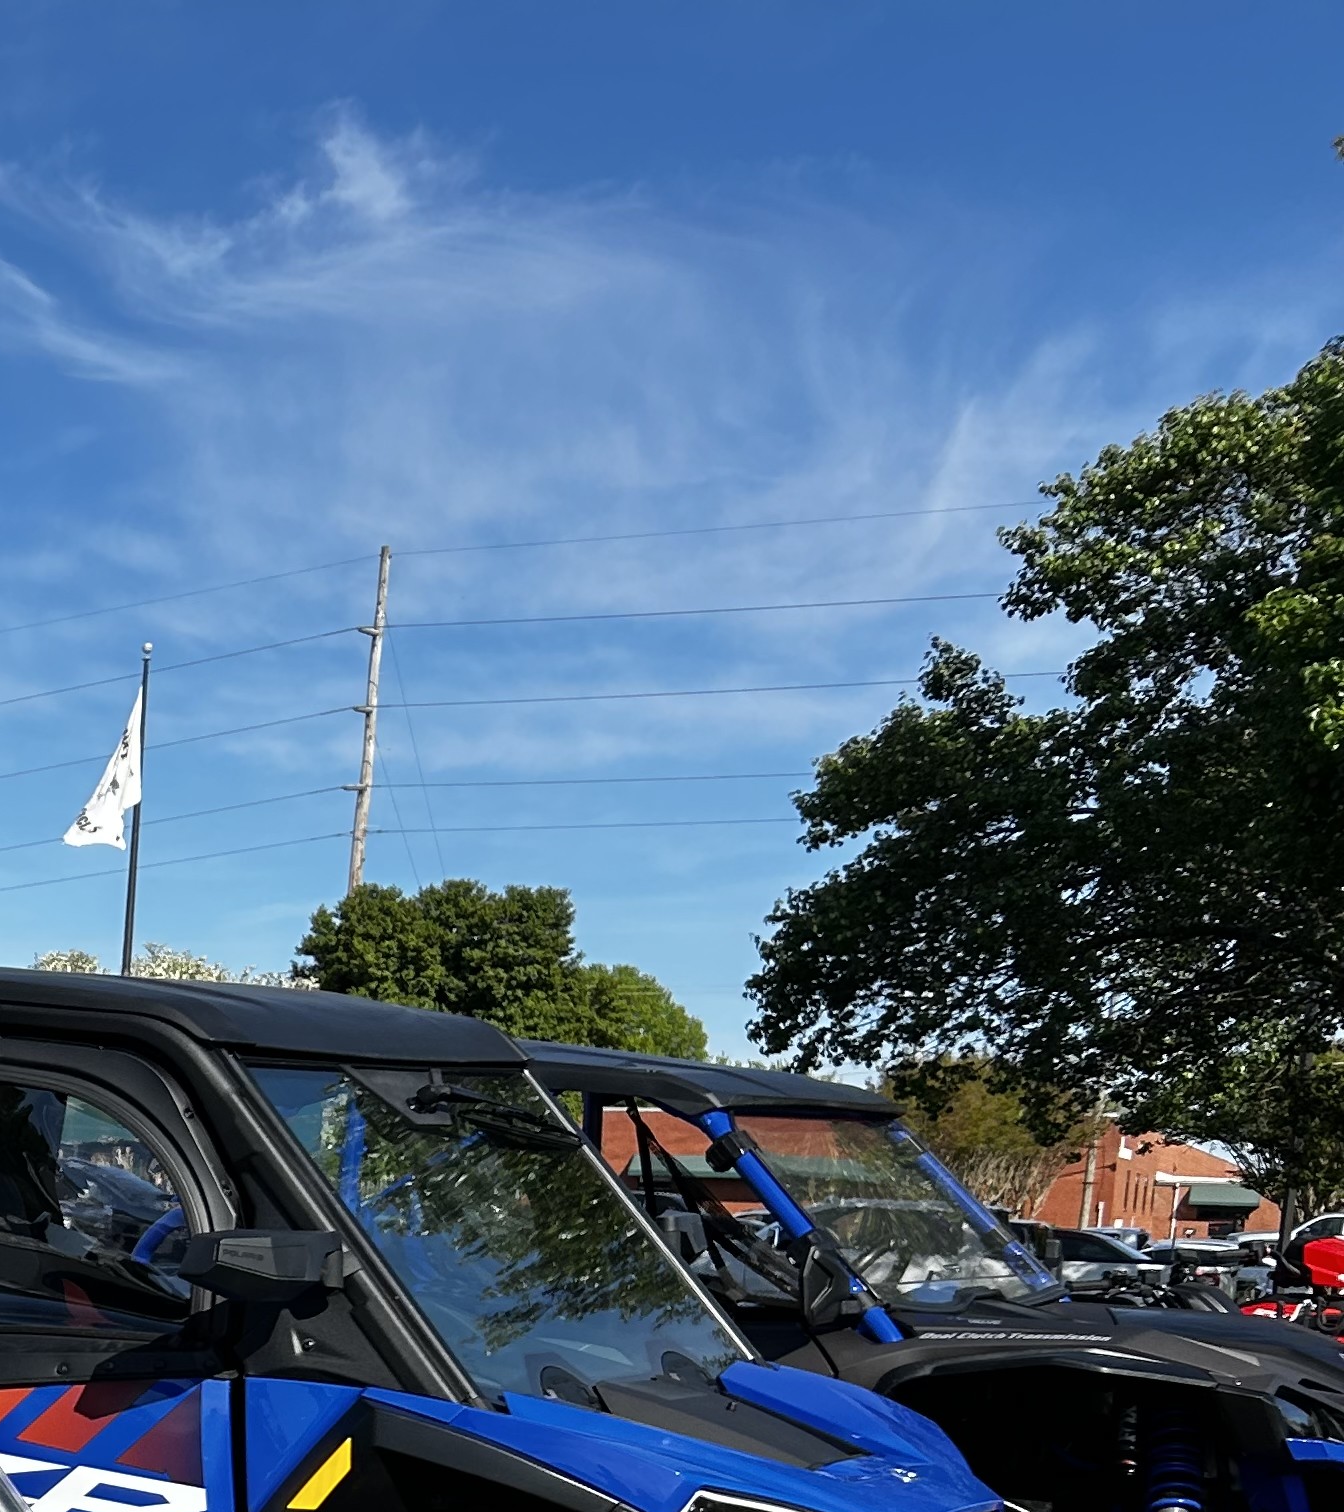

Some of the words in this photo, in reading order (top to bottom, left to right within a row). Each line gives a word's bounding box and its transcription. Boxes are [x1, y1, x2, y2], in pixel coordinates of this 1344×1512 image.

[918, 1332, 957, 1341] Dual
[957, 1332, 1007, 1341] Clutch
[1008, 1332, 1112, 1342] Transmission
